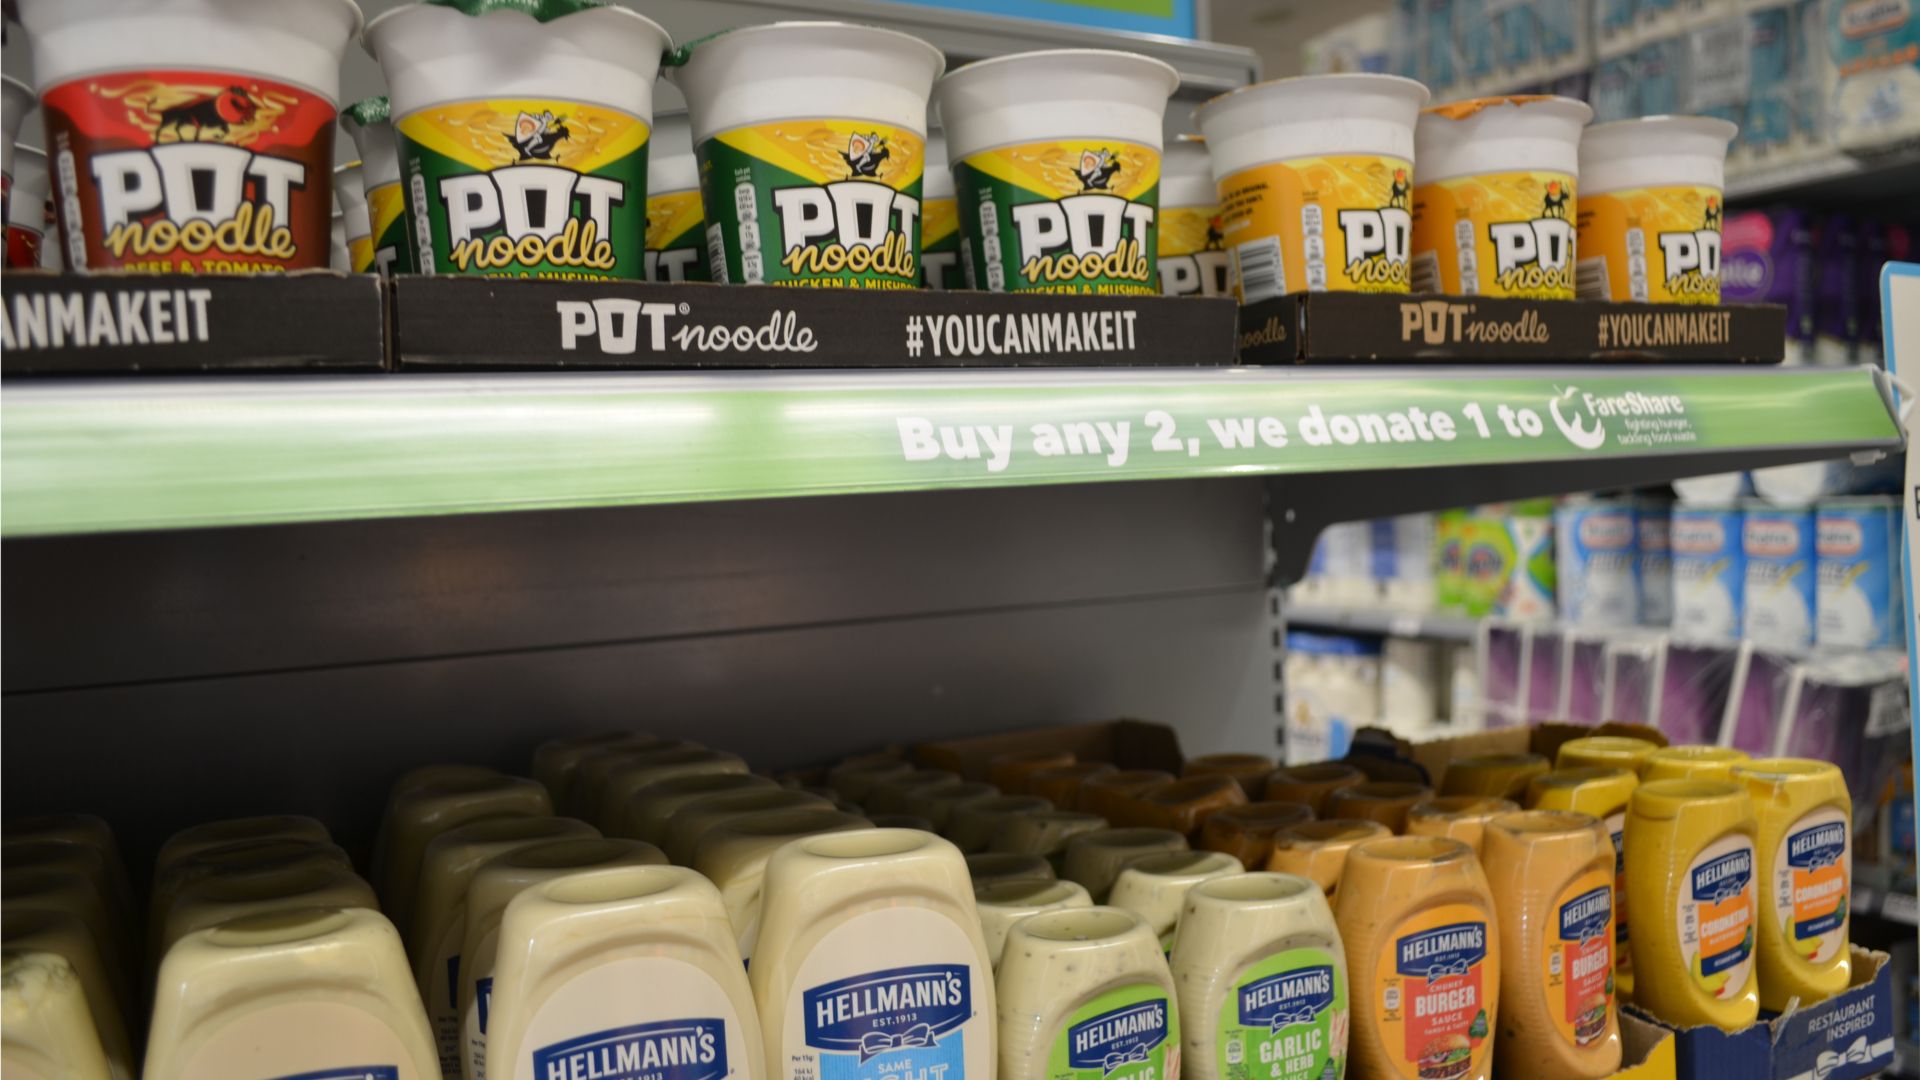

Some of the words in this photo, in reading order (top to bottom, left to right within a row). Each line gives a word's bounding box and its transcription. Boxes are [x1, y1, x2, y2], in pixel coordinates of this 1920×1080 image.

[92, 142, 304, 238] POT
[440, 166, 623, 250] POT
[104, 201, 295, 258] noodle
[775, 182, 919, 254] POT
[1013, 195, 1154, 264] POT
[1341, 208, 1412, 268] PO
[450, 218, 616, 270] noodle
[782, 230, 915, 277] noodle
[1022, 238, 1149, 282] noodle
[1490, 219, 1577, 272] PO
[1660, 231, 1720, 274] PO
[1158, 253, 1236, 296] PO
[557, 299, 676, 354] POT
[672, 310, 818, 351] noodle
[906, 310, 1137, 357] #YOUCANMAKEIT
[1400, 301, 1469, 344] POT
[1466, 310, 1549, 342] noodle
[1599, 312, 1731, 346] #YOUCANMAKEIT
[1582, 391, 1684, 417] FareShare
[897, 417, 1013, 472] Buy
[1029, 421, 1130, 467] any
[1144, 410, 1200, 457] 2,
[1206, 417, 1288, 449] we
[1299, 405, 1457, 446] donate
[1463, 403, 1491, 438] 1
[1497, 404, 1543, 437] to
[1792, 824, 1845, 857] HELLMANN'S
[1696, 852, 1750, 891] HELLMANN'S
[1403, 925, 1482, 963] HELLMANN'S
[1572, 946, 1608, 980] BURGER
[816, 971, 961, 1028] HELLMANN'S
[1245, 969, 1330, 1013] HELLMANN'S
[1415, 985, 1475, 1018] BURGER
[1076, 1004, 1164, 1055] HELLMANN'S
[1431, 1011, 1463, 1026] SAUCE
[1808, 994, 1875, 1034] RESTAURANT
[1826, 1011, 1875, 1043] INSPIRED
[547, 1026, 716, 1080] HELLMANN'S
[878, 1060, 912, 1074] SAME
[1260, 1028, 1321, 1064] GARLIC
[1270, 1062, 1282, 1078] &
[1285, 1054, 1314, 1073] HERB
